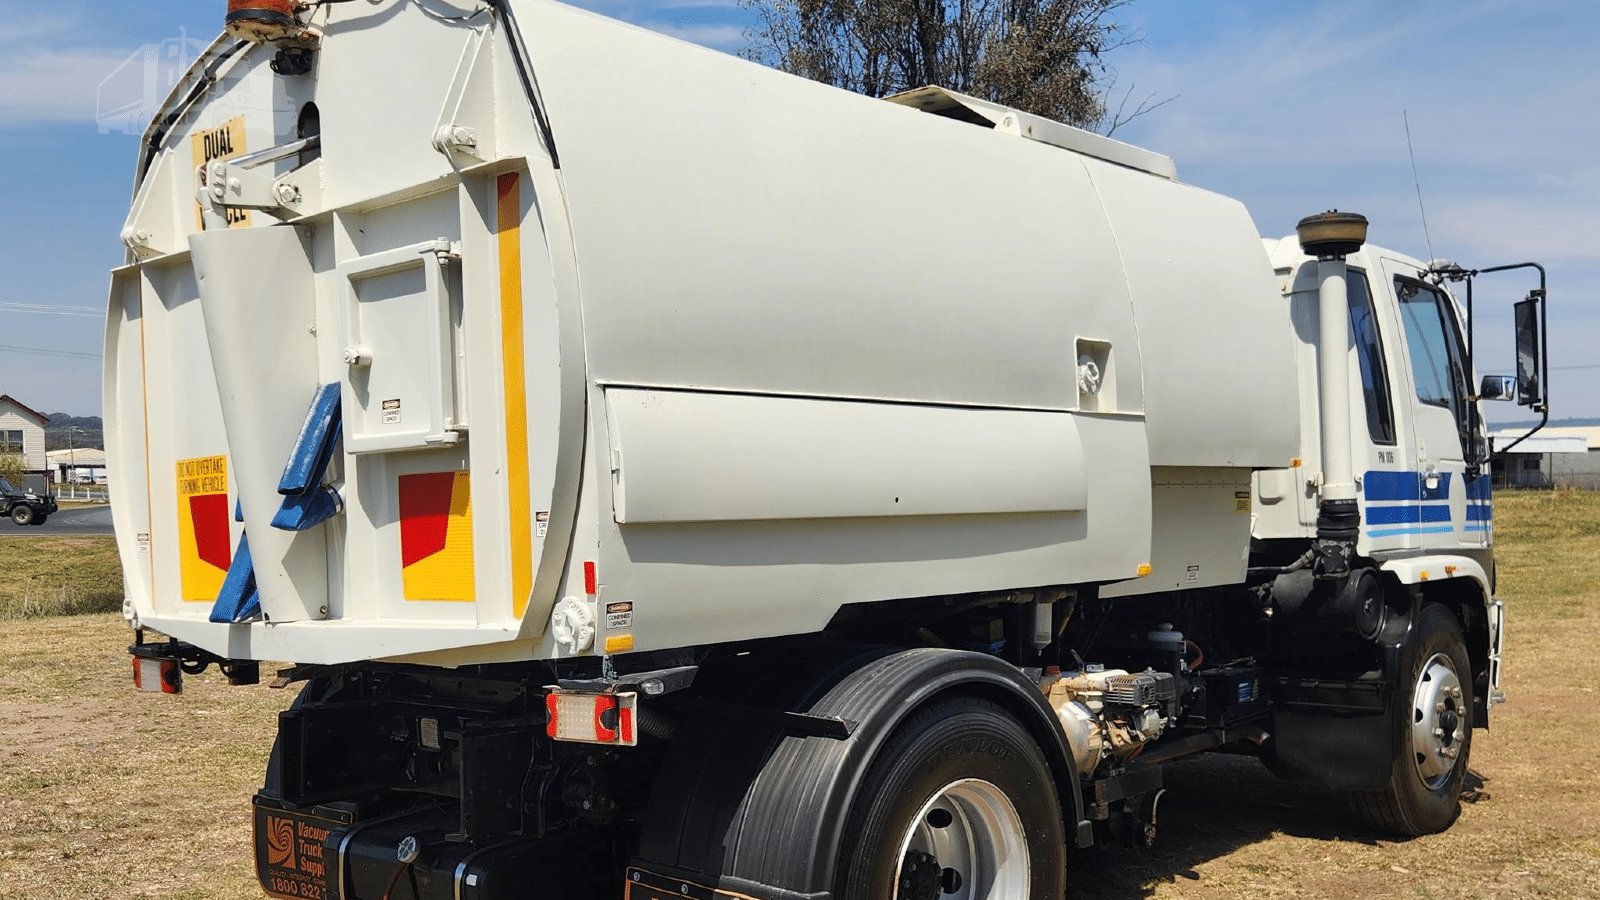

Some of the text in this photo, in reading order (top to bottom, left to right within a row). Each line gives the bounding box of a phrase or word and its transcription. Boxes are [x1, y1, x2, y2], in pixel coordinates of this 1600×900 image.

[204, 126, 233, 162] DUAL
[196, 457, 224, 475] OVERTAKE
[608, 612, 632, 621] CONFINED
[612, 619, 627, 627] SPACE
[298, 838, 324, 859] Truck
[270, 876, 321, 900] 1800 822
